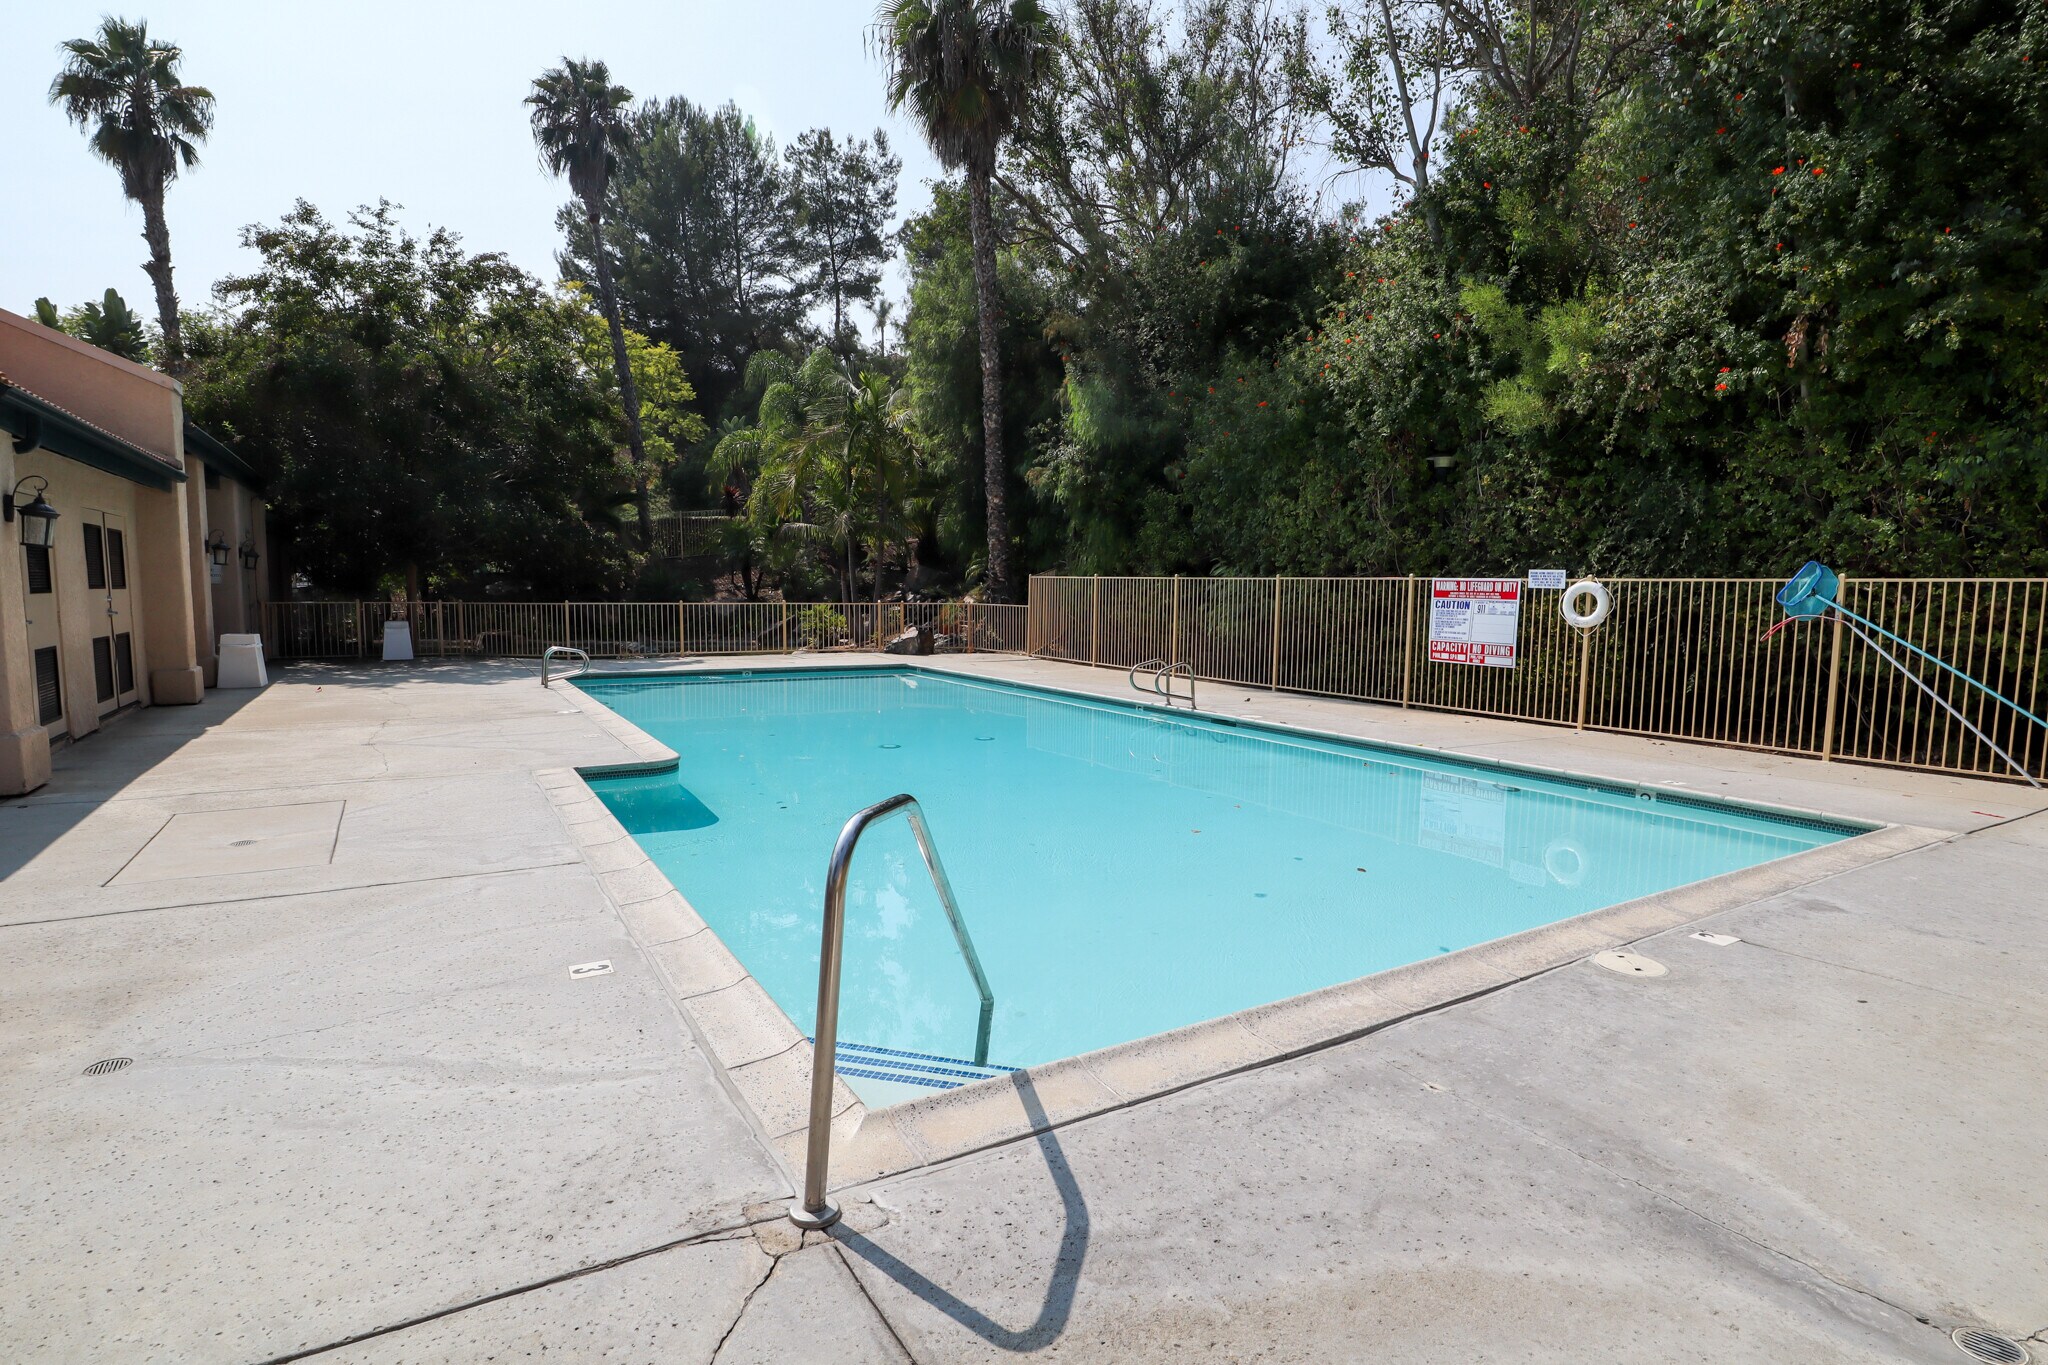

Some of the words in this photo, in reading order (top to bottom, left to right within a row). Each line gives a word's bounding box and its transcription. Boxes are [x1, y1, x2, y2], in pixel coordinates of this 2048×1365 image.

[1467, 581, 1494, 593] LIFEGUARD
[1503, 581, 1517, 593] DUTY
[1435, 600, 1471, 610] CAUTION
[1477, 605, 1486, 614] 911
[1432, 641, 1467, 653] CAPACITY
[1472, 644, 1482, 654] NO
[1484, 645, 1510, 656] DIVING
